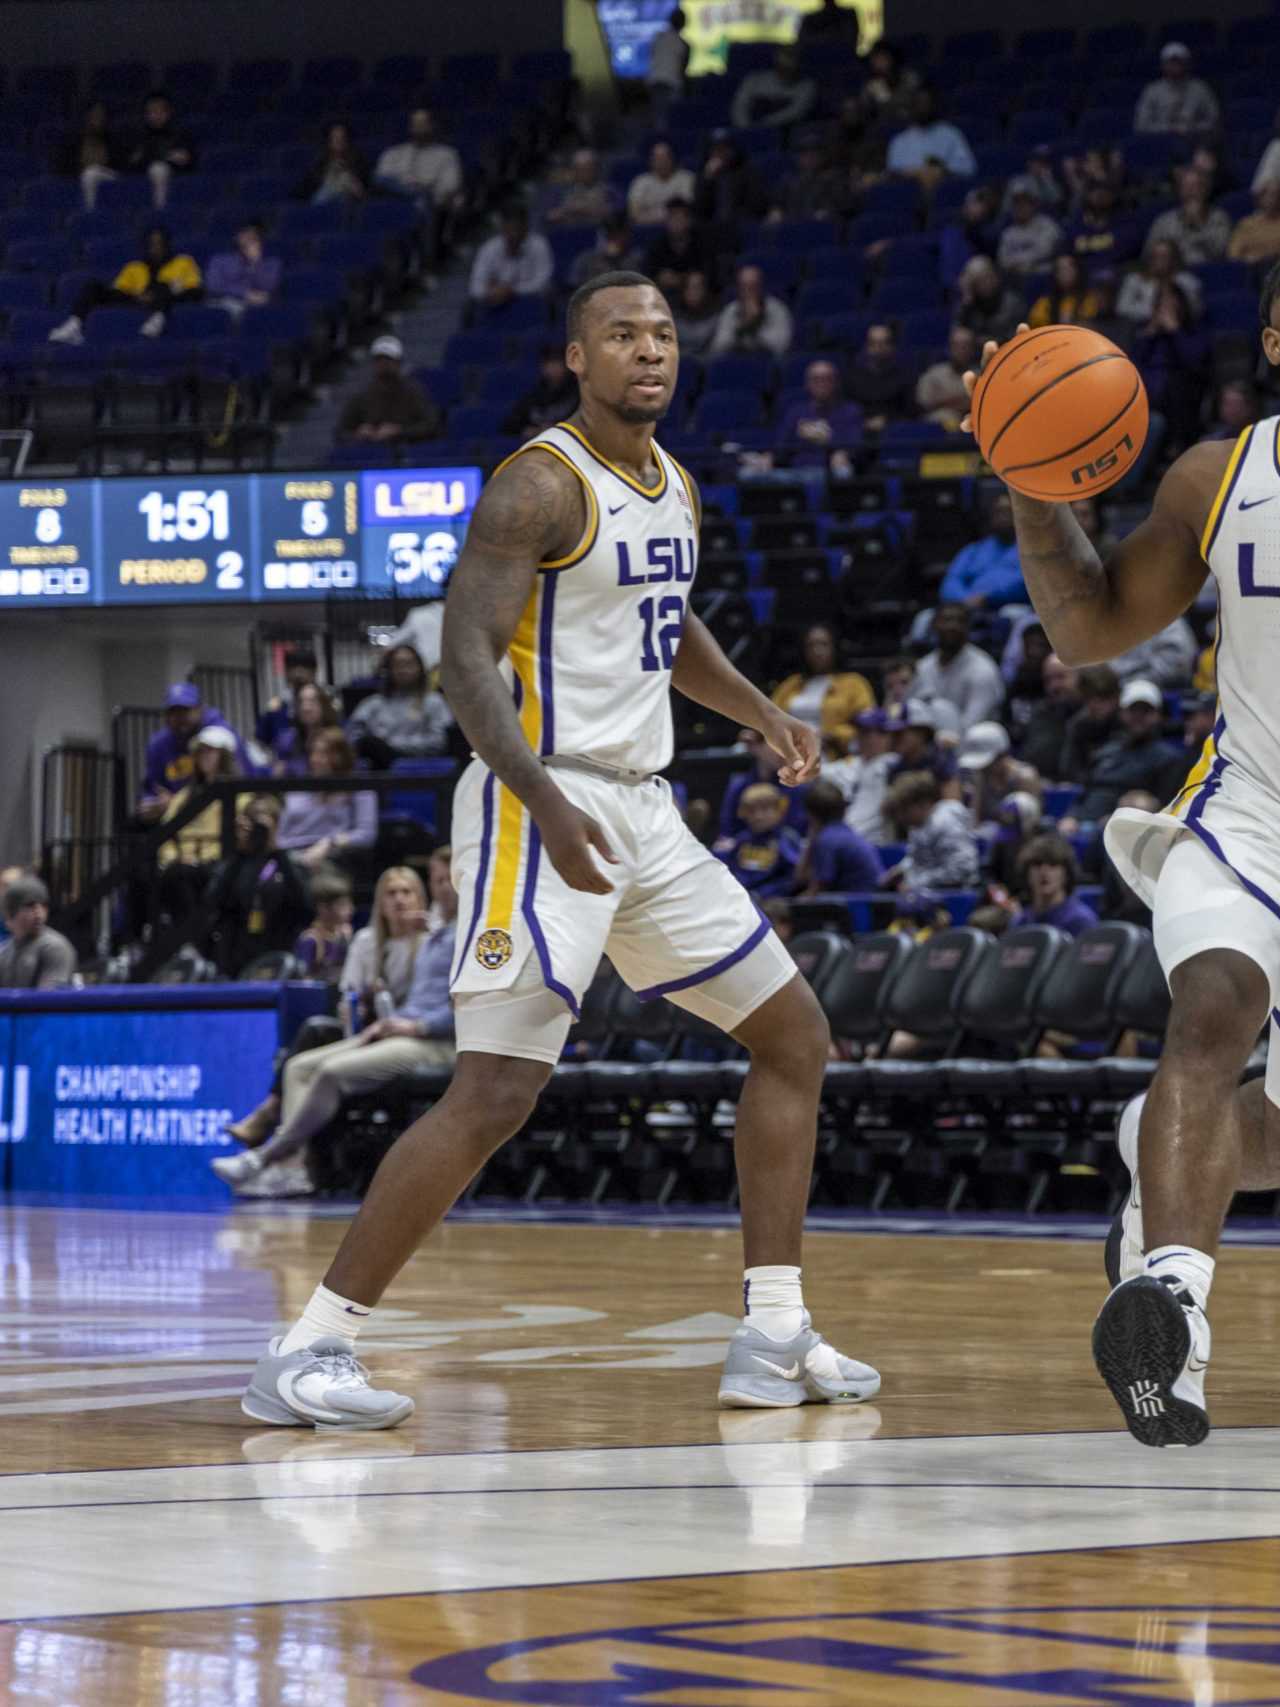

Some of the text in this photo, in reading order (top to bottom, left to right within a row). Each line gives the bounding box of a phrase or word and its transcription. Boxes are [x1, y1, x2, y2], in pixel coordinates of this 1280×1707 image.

[139, 490, 229, 542] 1:51
[374, 481, 466, 518] LSU
[119, 558, 207, 585] PERIOD
[216, 551, 244, 590] 2
[616, 537, 694, 586] LSU
[638, 595, 684, 672] 12
[56, 1064, 201, 1101] CHAMPIONSHIP
[54, 1107, 233, 1146] HEALTH PARTNERS
